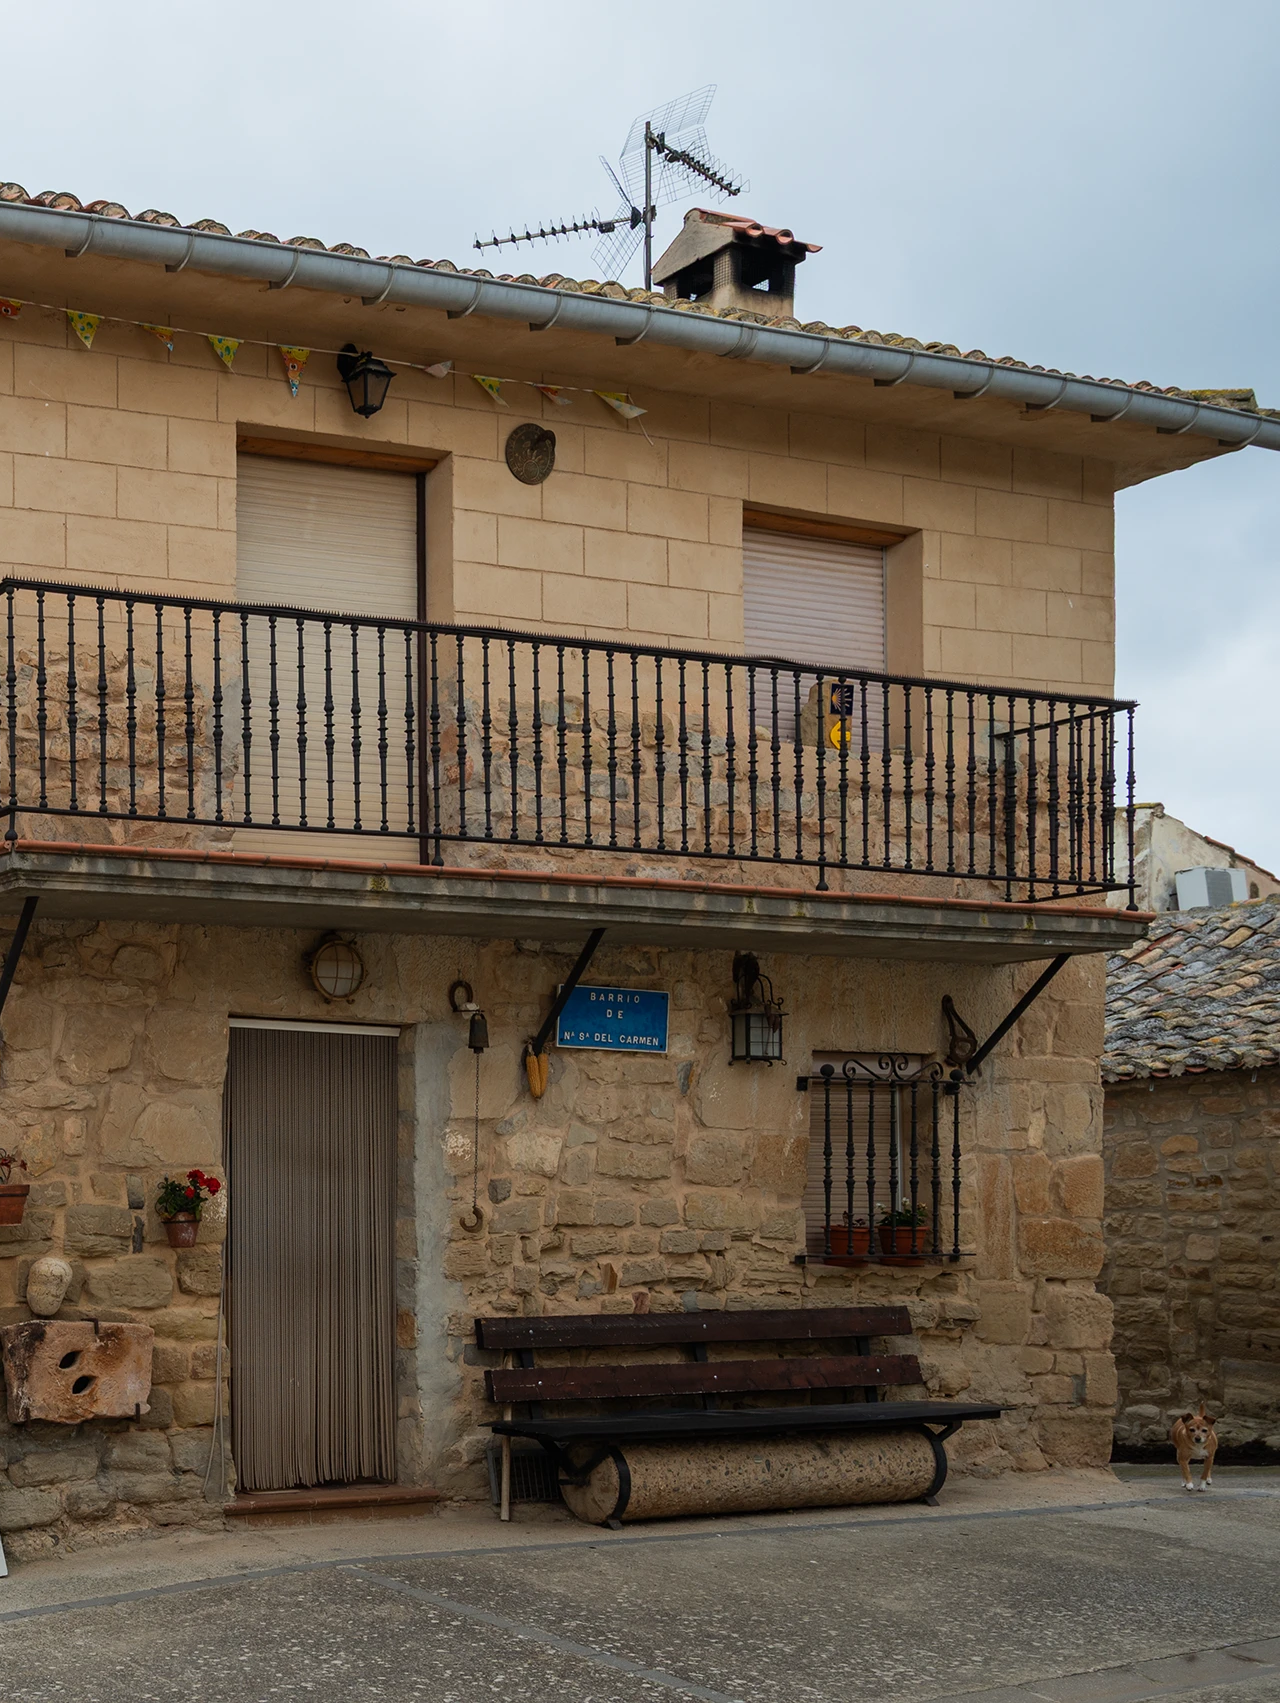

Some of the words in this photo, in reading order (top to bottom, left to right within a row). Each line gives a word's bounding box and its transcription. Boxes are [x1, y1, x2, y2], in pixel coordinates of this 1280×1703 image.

[590, 992, 640, 1004] BARRIO
[606, 1009, 624, 1019] DE
[594, 1033, 613, 1043] DEL
[619, 1034, 659, 1046] CARMEN
